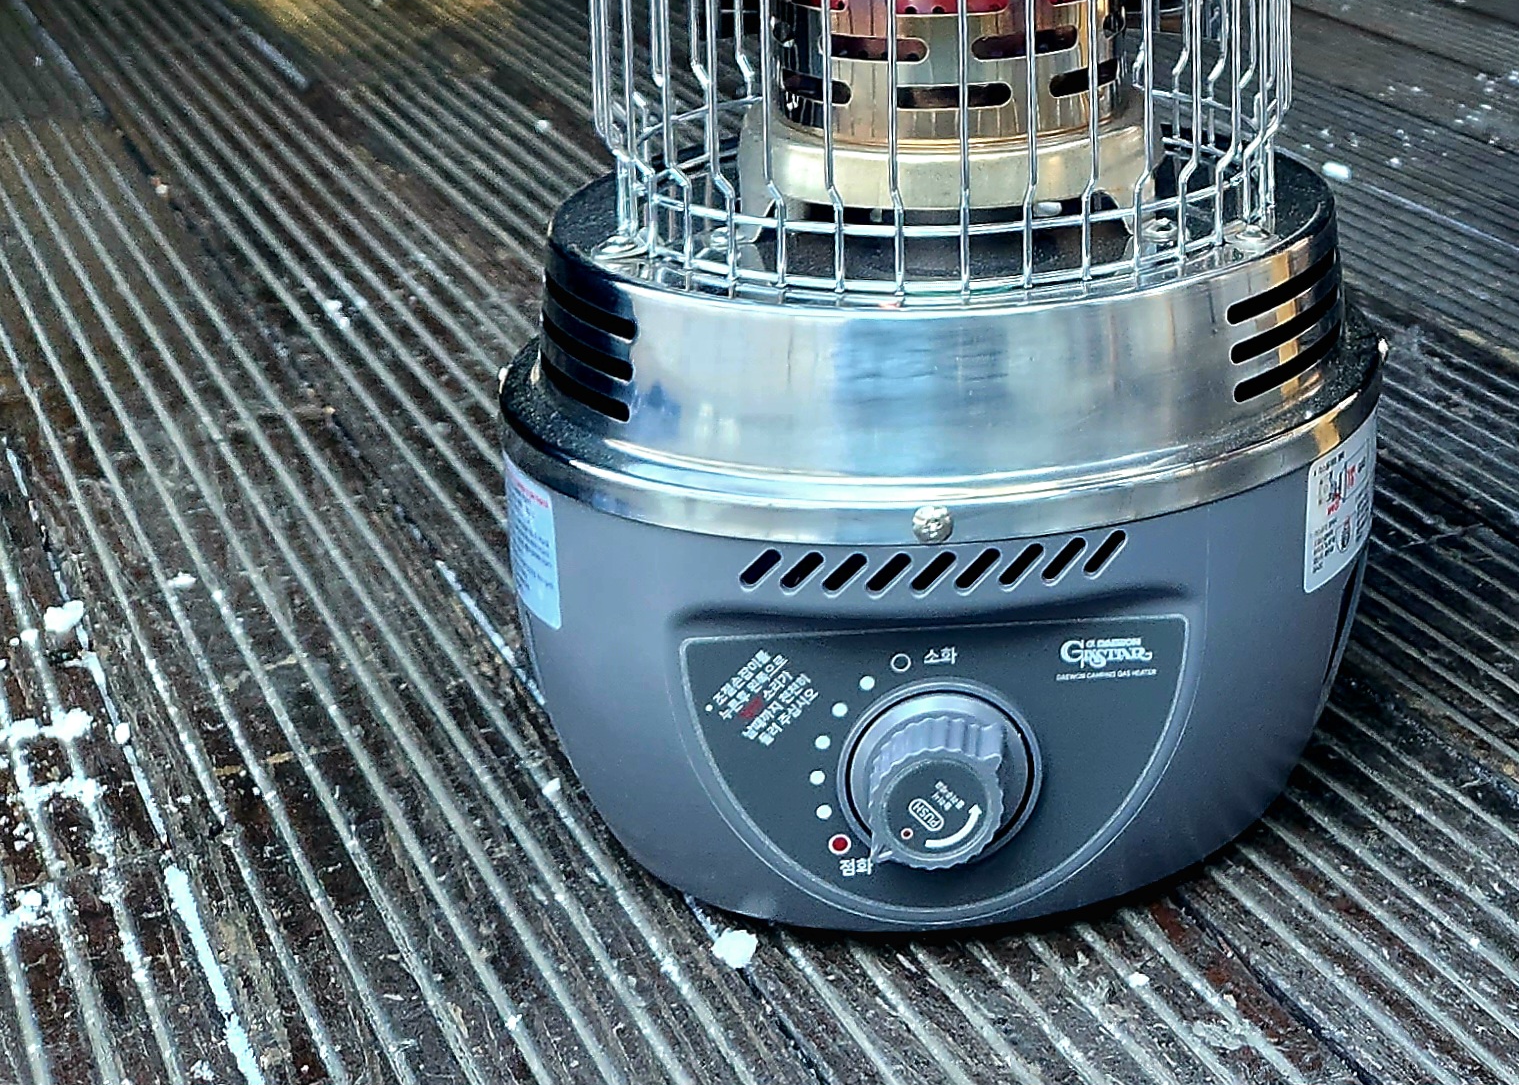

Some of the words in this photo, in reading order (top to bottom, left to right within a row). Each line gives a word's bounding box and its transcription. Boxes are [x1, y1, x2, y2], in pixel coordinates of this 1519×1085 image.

[923, 646, 958, 665] 소화
[763, 670, 793, 701] 소리가
[1117, 669, 1131, 678] GAS
[1131, 668, 1157, 677] HEATER
[778, 673, 811, 704] 천천히
[758, 722, 783, 746] 돌려
[777, 688, 819, 726] 주십시오
[912, 801, 941, 828] PUSH
[839, 857, 874, 877] 점화
